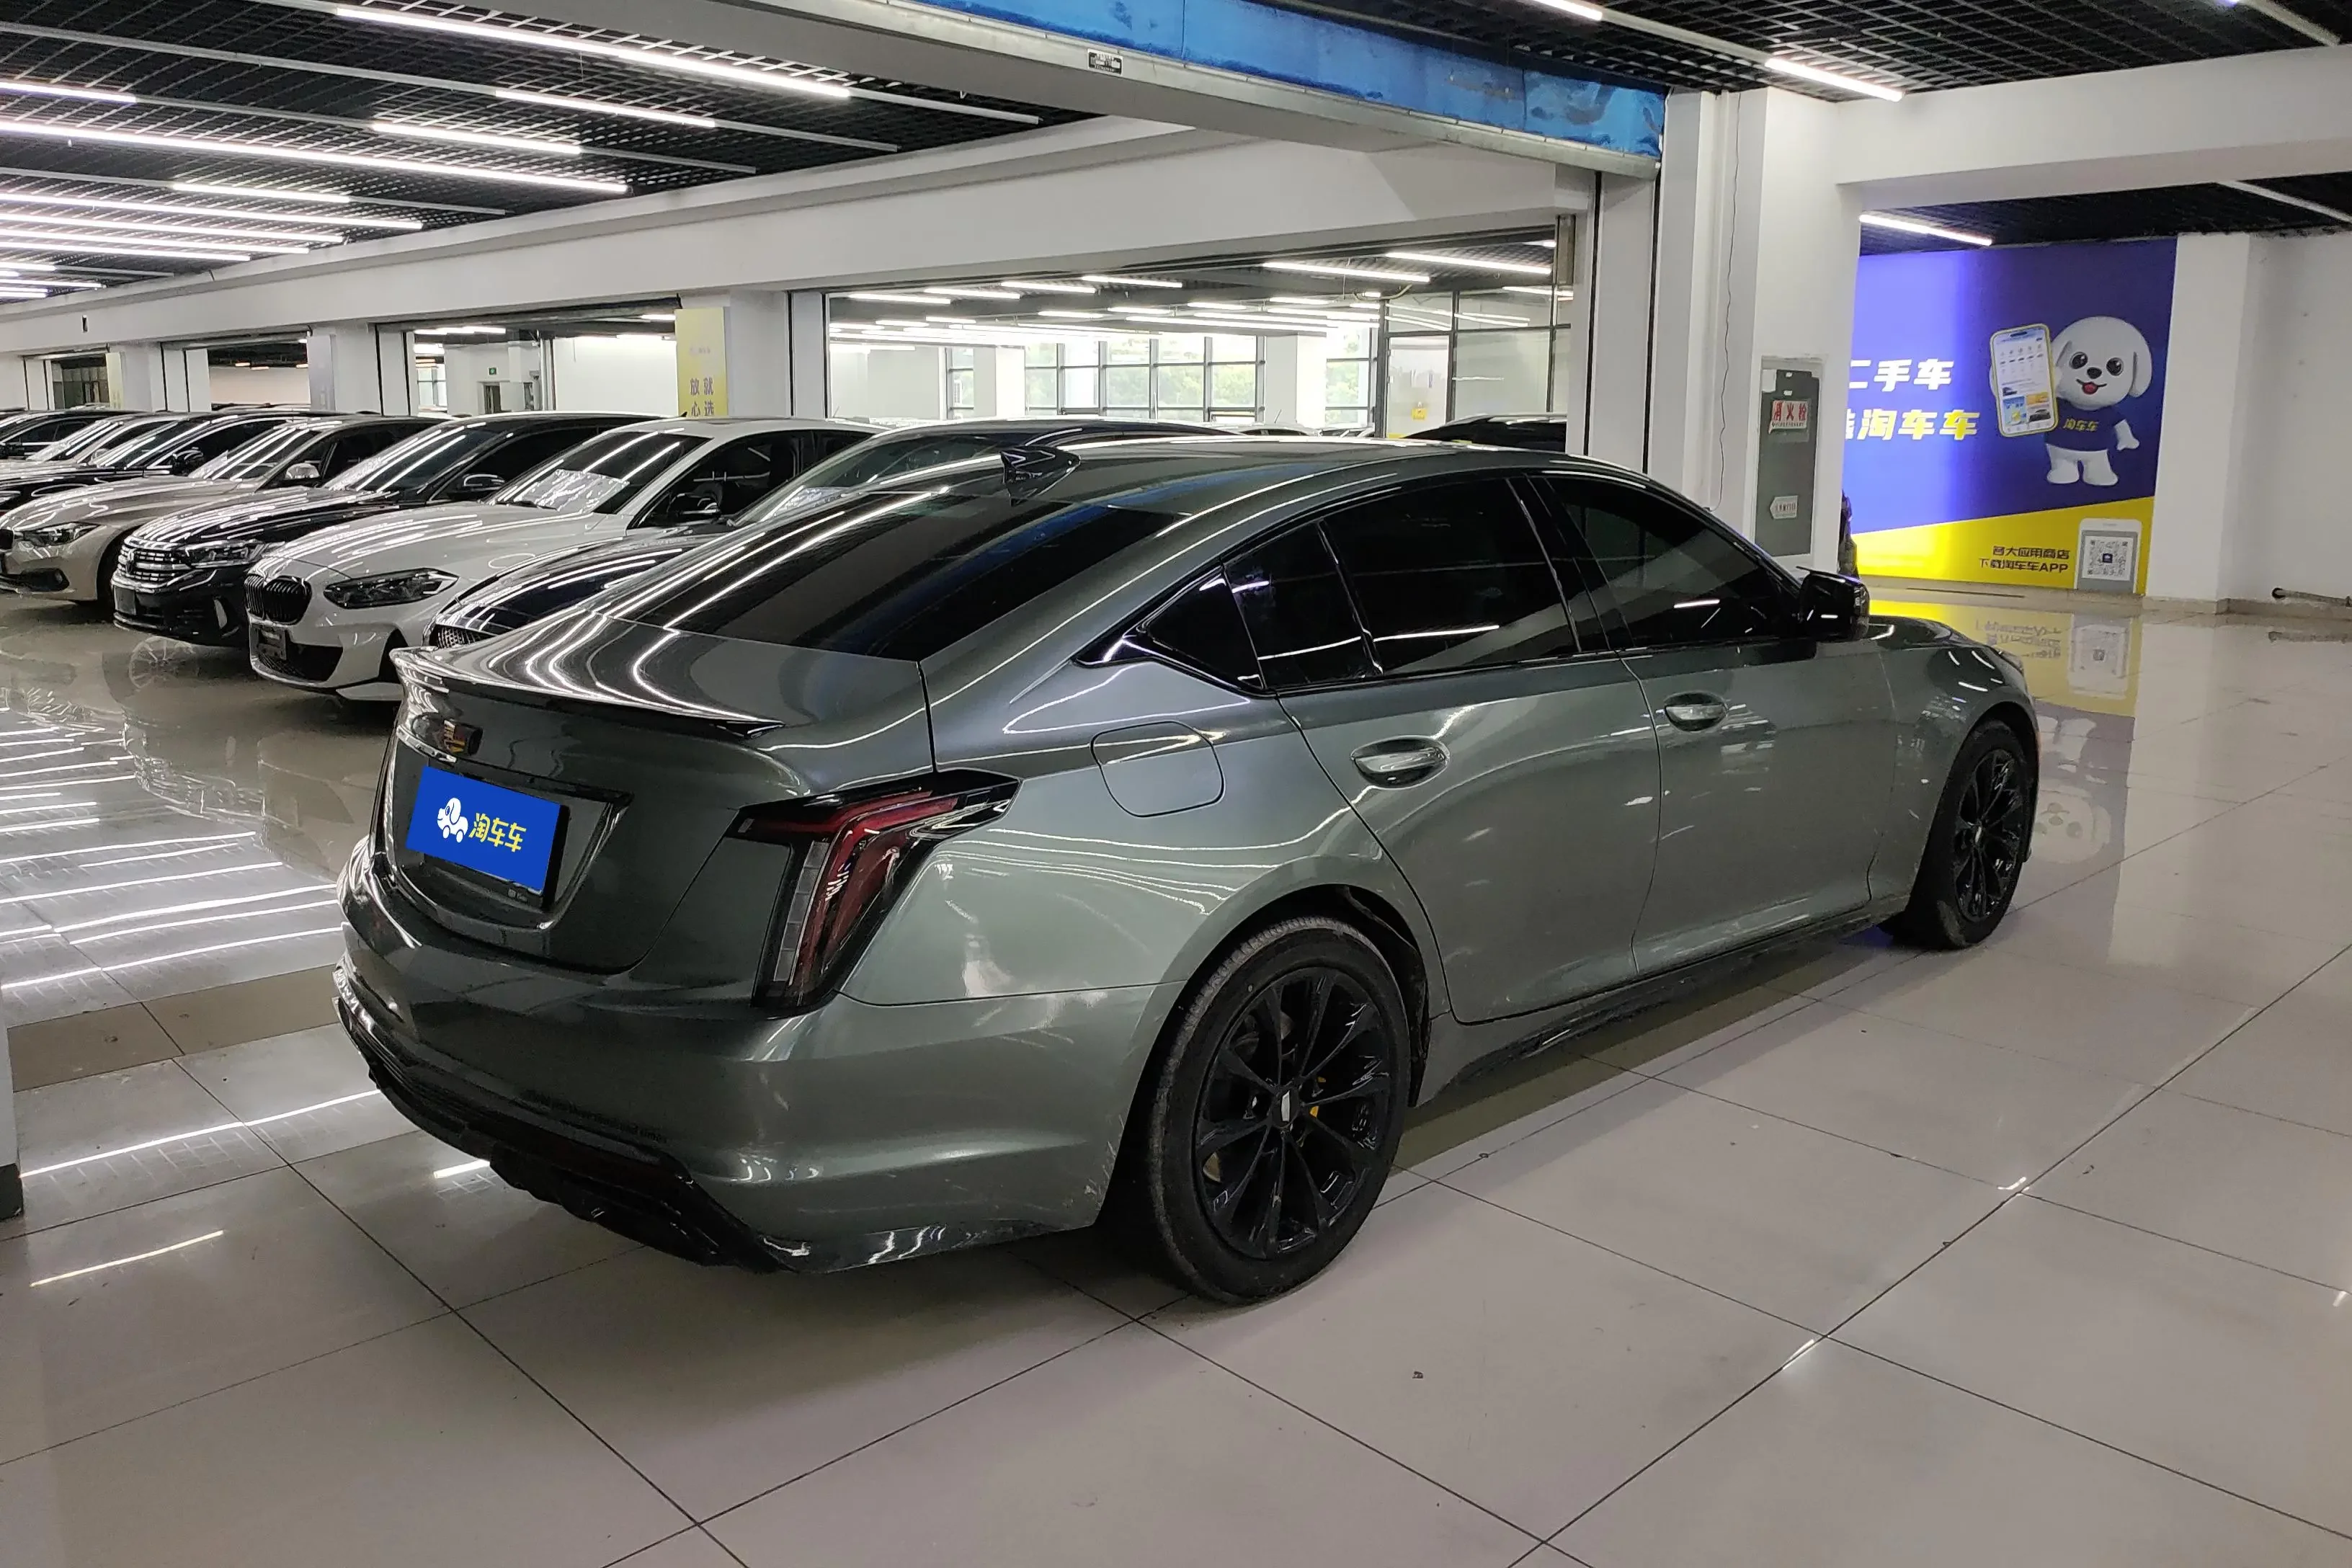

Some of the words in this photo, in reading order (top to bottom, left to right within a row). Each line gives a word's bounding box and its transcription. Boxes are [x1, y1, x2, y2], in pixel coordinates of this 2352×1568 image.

[1773, 401, 1807, 422] 消火栓
[1992, 545, 2071, 560] 各大应用商店
